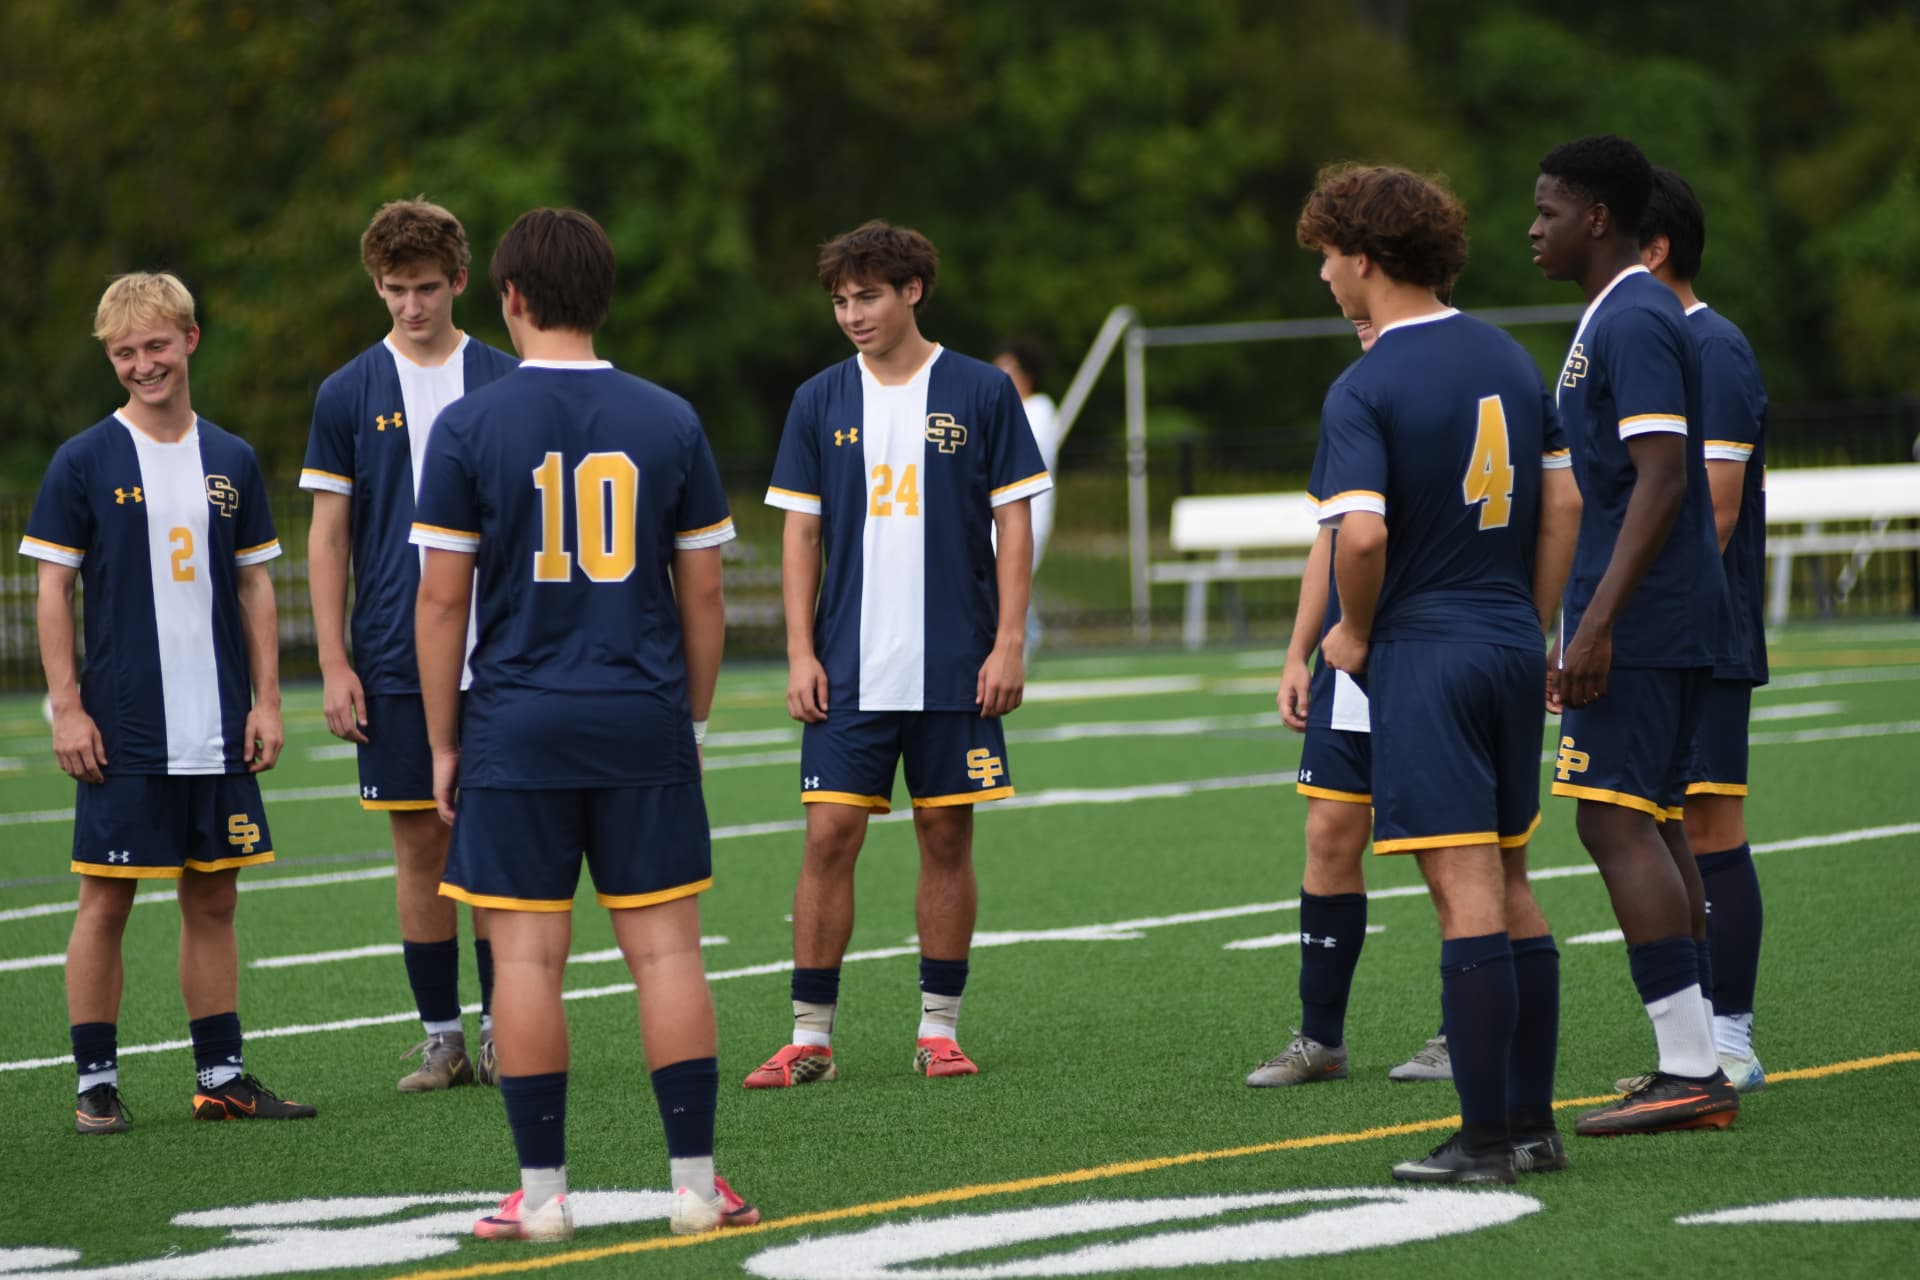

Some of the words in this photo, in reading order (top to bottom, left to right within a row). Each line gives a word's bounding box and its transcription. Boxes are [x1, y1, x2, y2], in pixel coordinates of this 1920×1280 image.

[925, 412, 968, 454] SP
[1462, 394, 1515, 531] 4
[205, 474, 239, 518] SP
[532, 451, 639, 582] 10
[869, 463, 920, 517] 24
[168, 526, 196, 583] 2
[228, 813, 260, 854] SP
